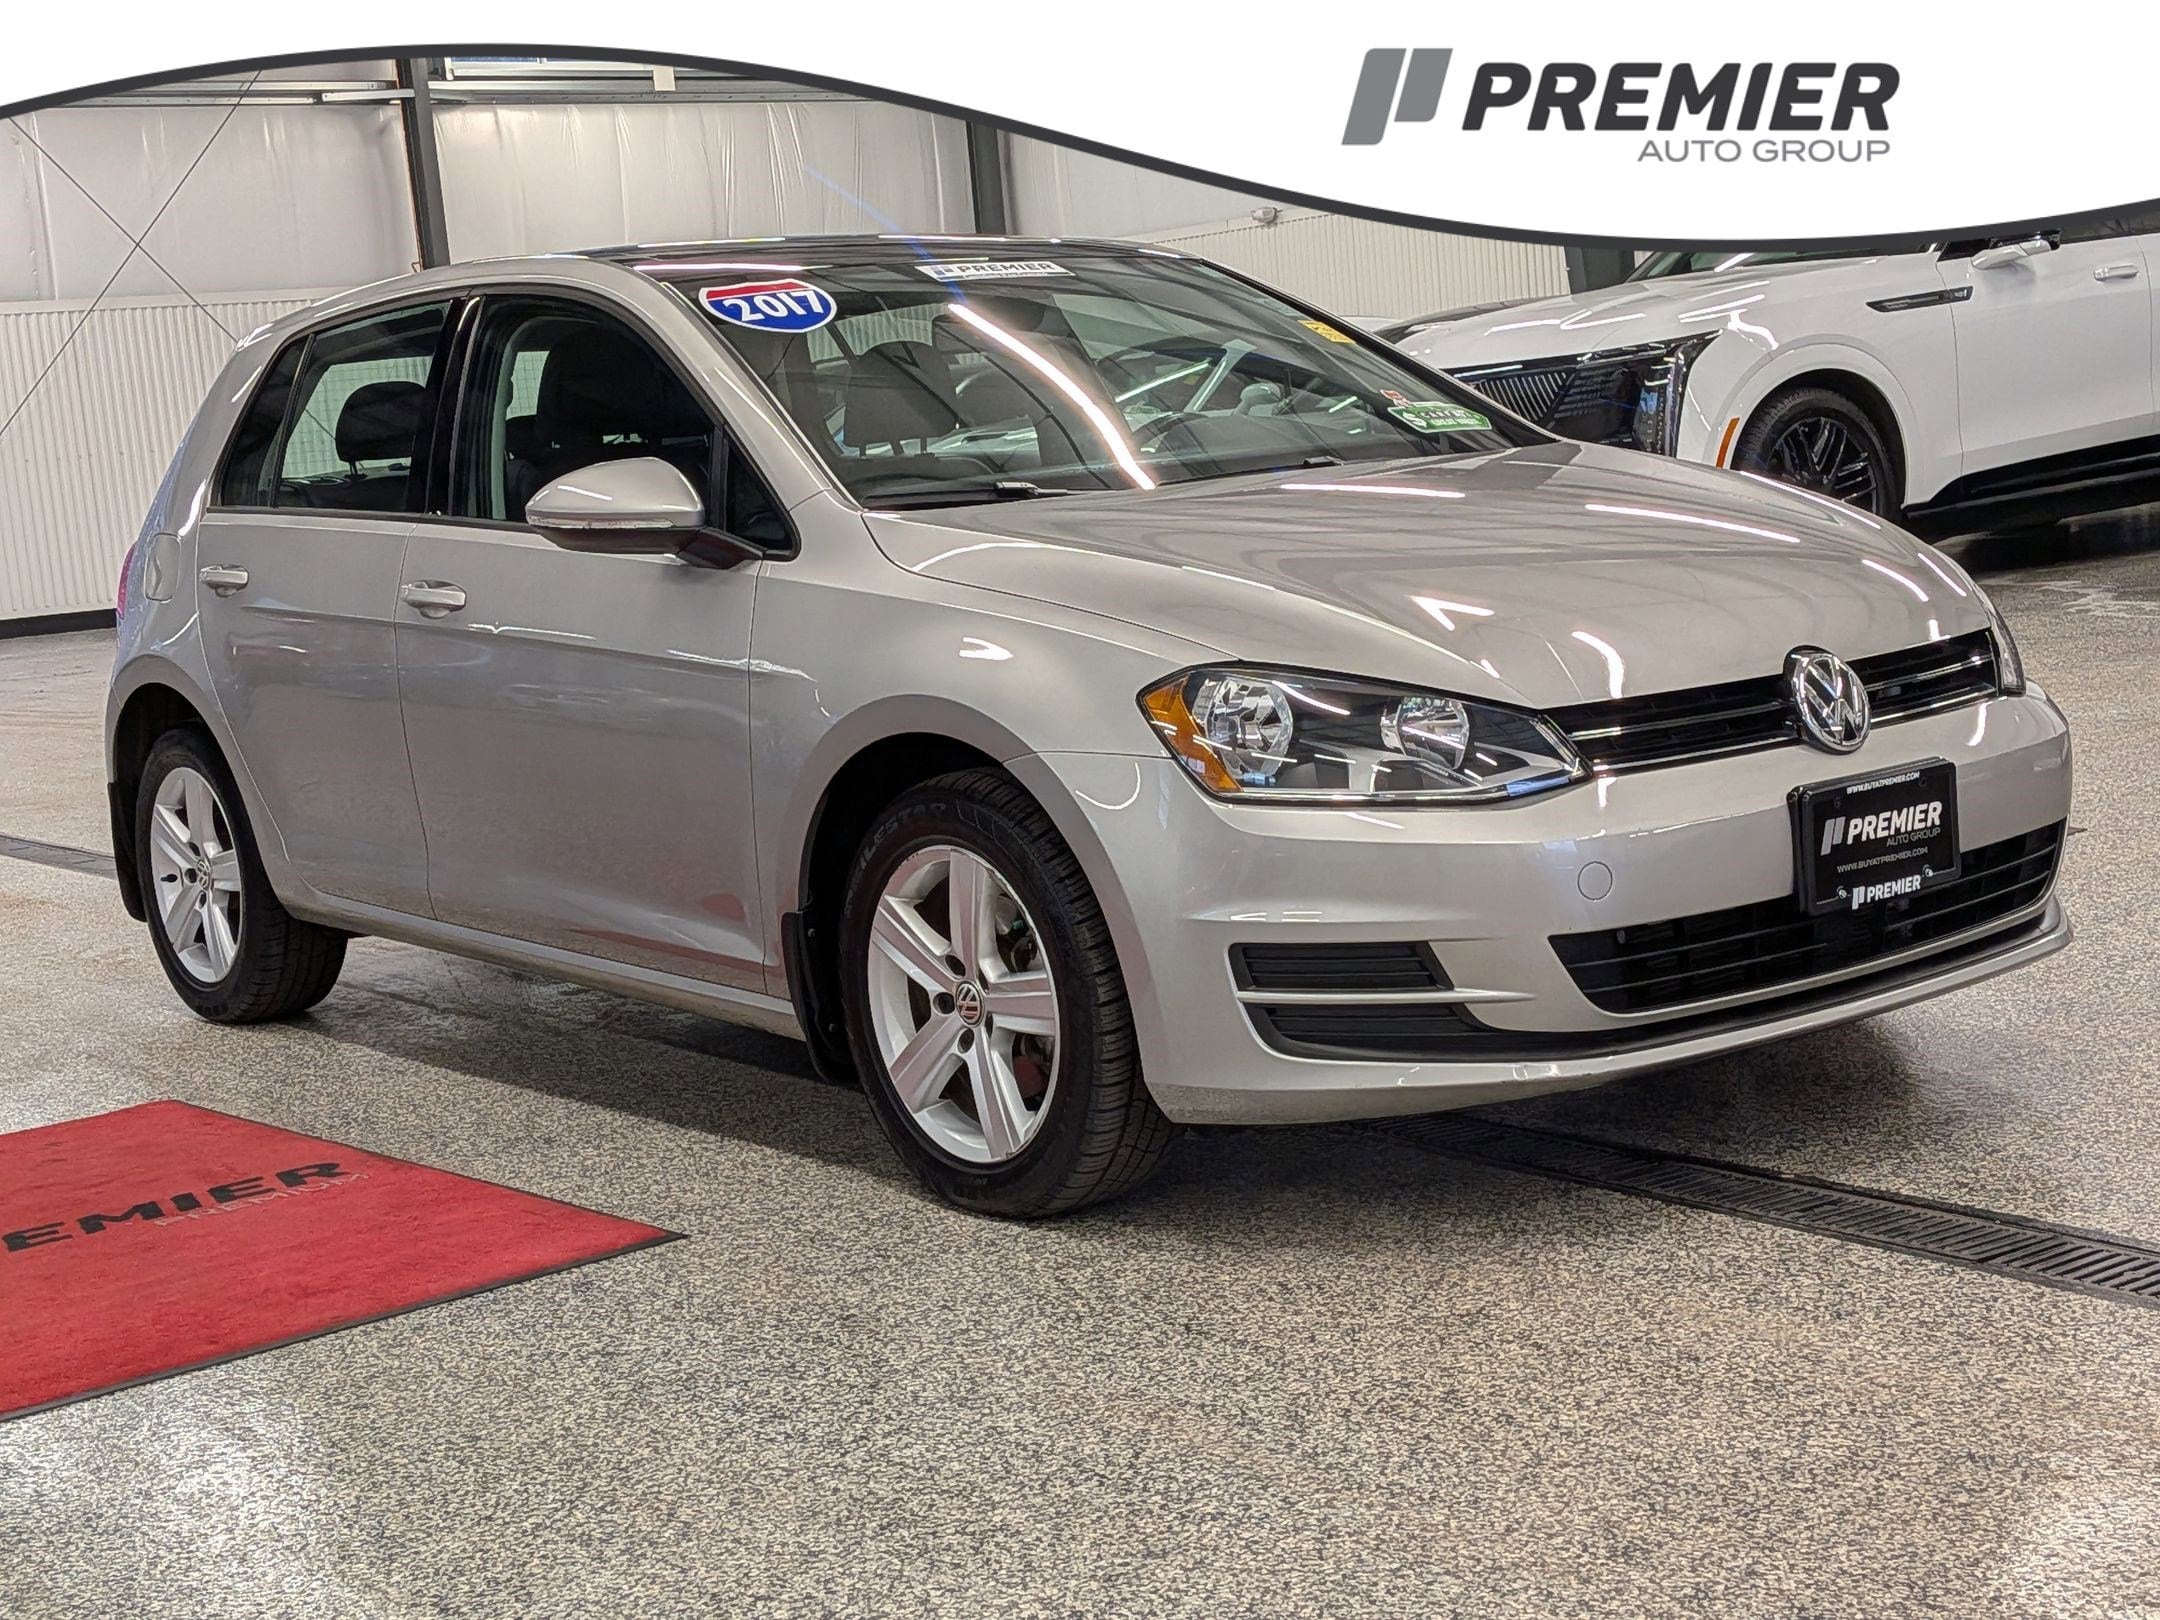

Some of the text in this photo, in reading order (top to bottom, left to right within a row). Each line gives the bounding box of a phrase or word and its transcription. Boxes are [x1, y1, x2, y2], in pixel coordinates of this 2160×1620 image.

[956, 262, 1055, 274] PREMIER
[722, 289, 825, 322] 2017
[1846, 800, 1943, 845] PREMIER
[1886, 826, 1941, 847] AUTO GROUP
[1866, 874, 1922, 903] PREMIER
